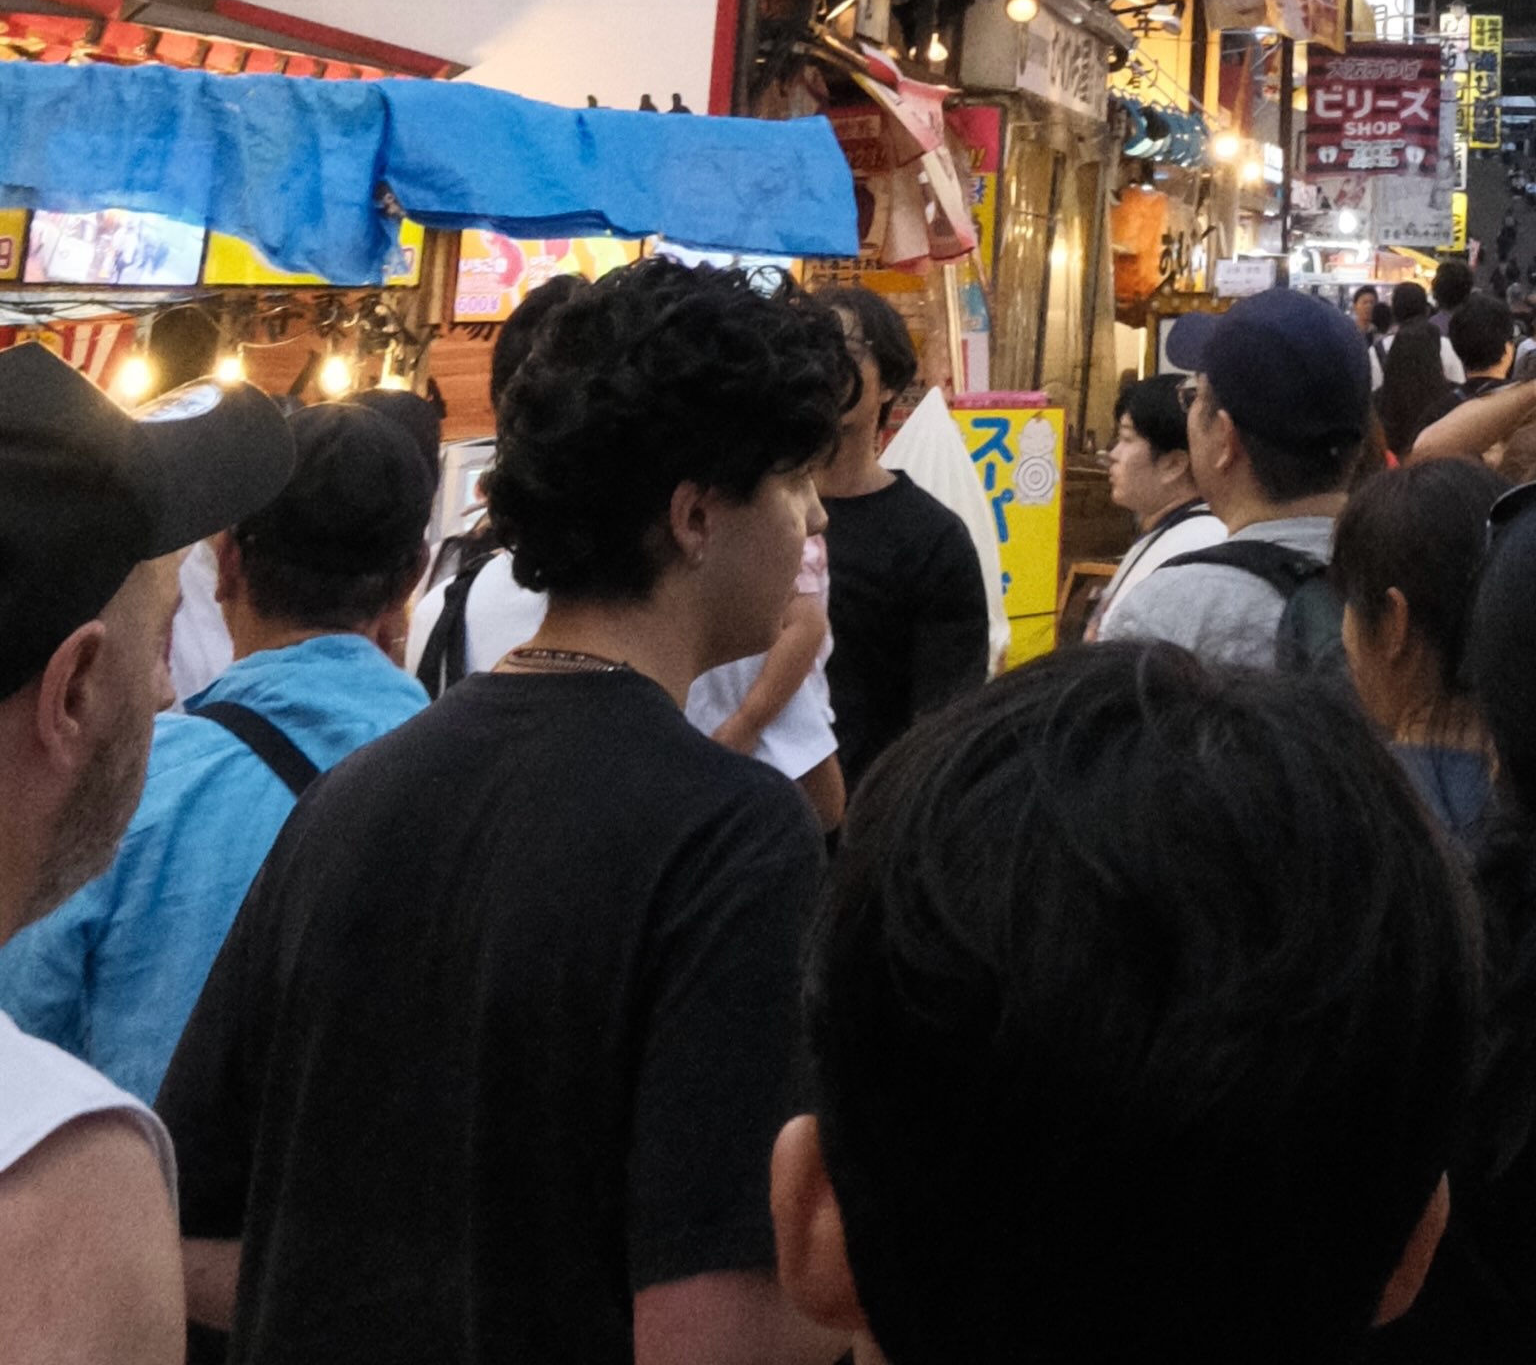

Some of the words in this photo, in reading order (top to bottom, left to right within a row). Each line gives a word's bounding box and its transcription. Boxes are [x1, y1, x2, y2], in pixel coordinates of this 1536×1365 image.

[1314, 84, 1431, 121] ビリーズ
[1344, 121, 1402, 136] SHOP
